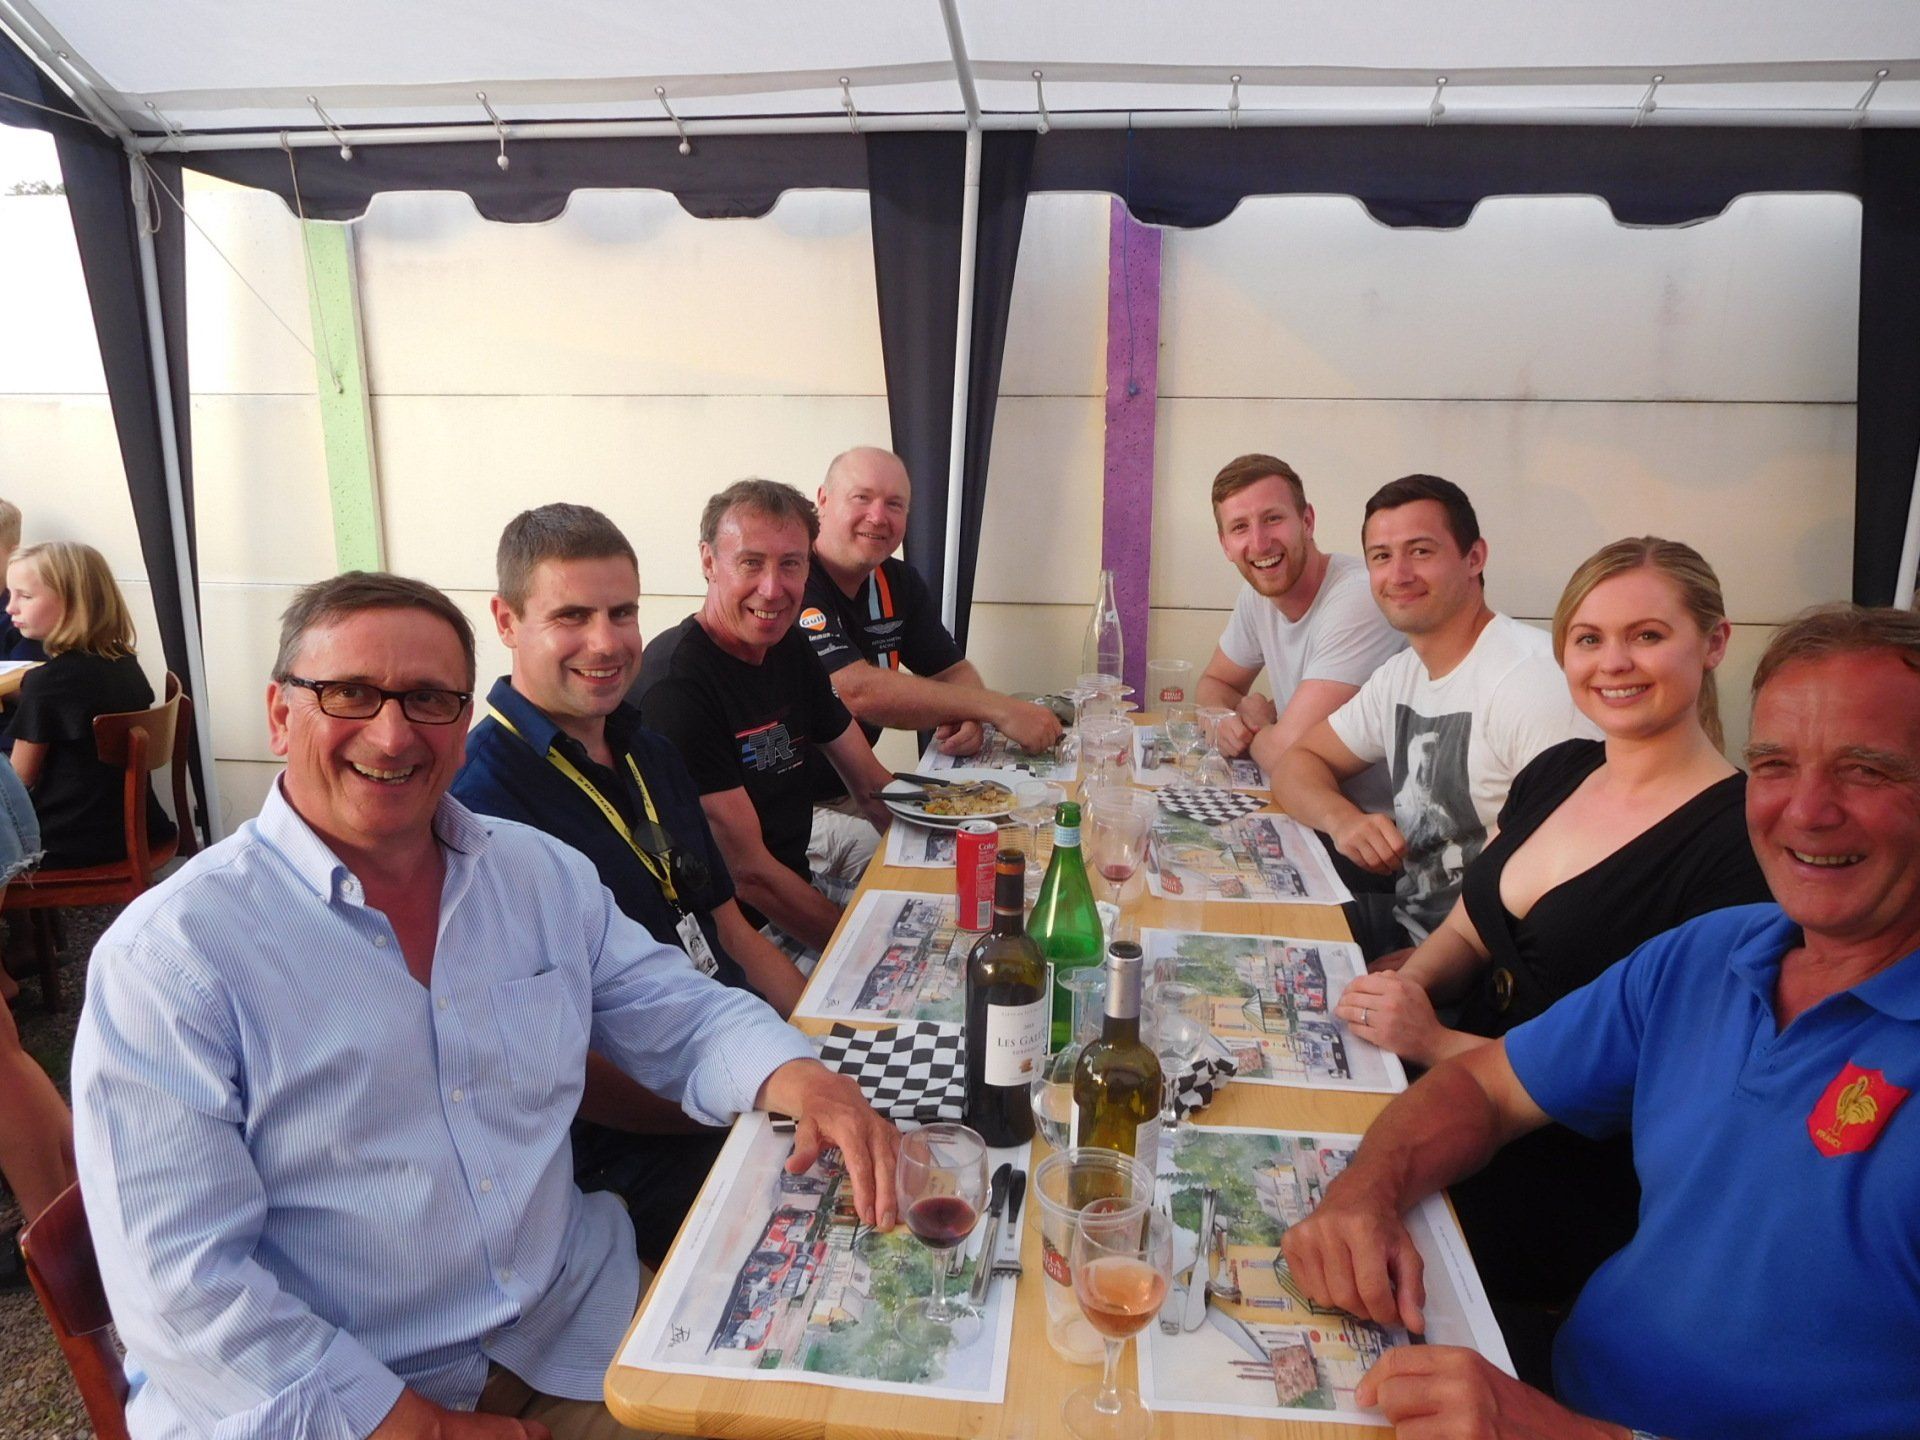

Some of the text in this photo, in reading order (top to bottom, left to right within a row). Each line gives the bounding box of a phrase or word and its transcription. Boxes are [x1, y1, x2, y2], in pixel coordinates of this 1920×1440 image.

[801, 614, 825, 627] Gulf
[584, 783, 614, 816] DUNLOP
[998, 1037, 1016, 1047] LES
